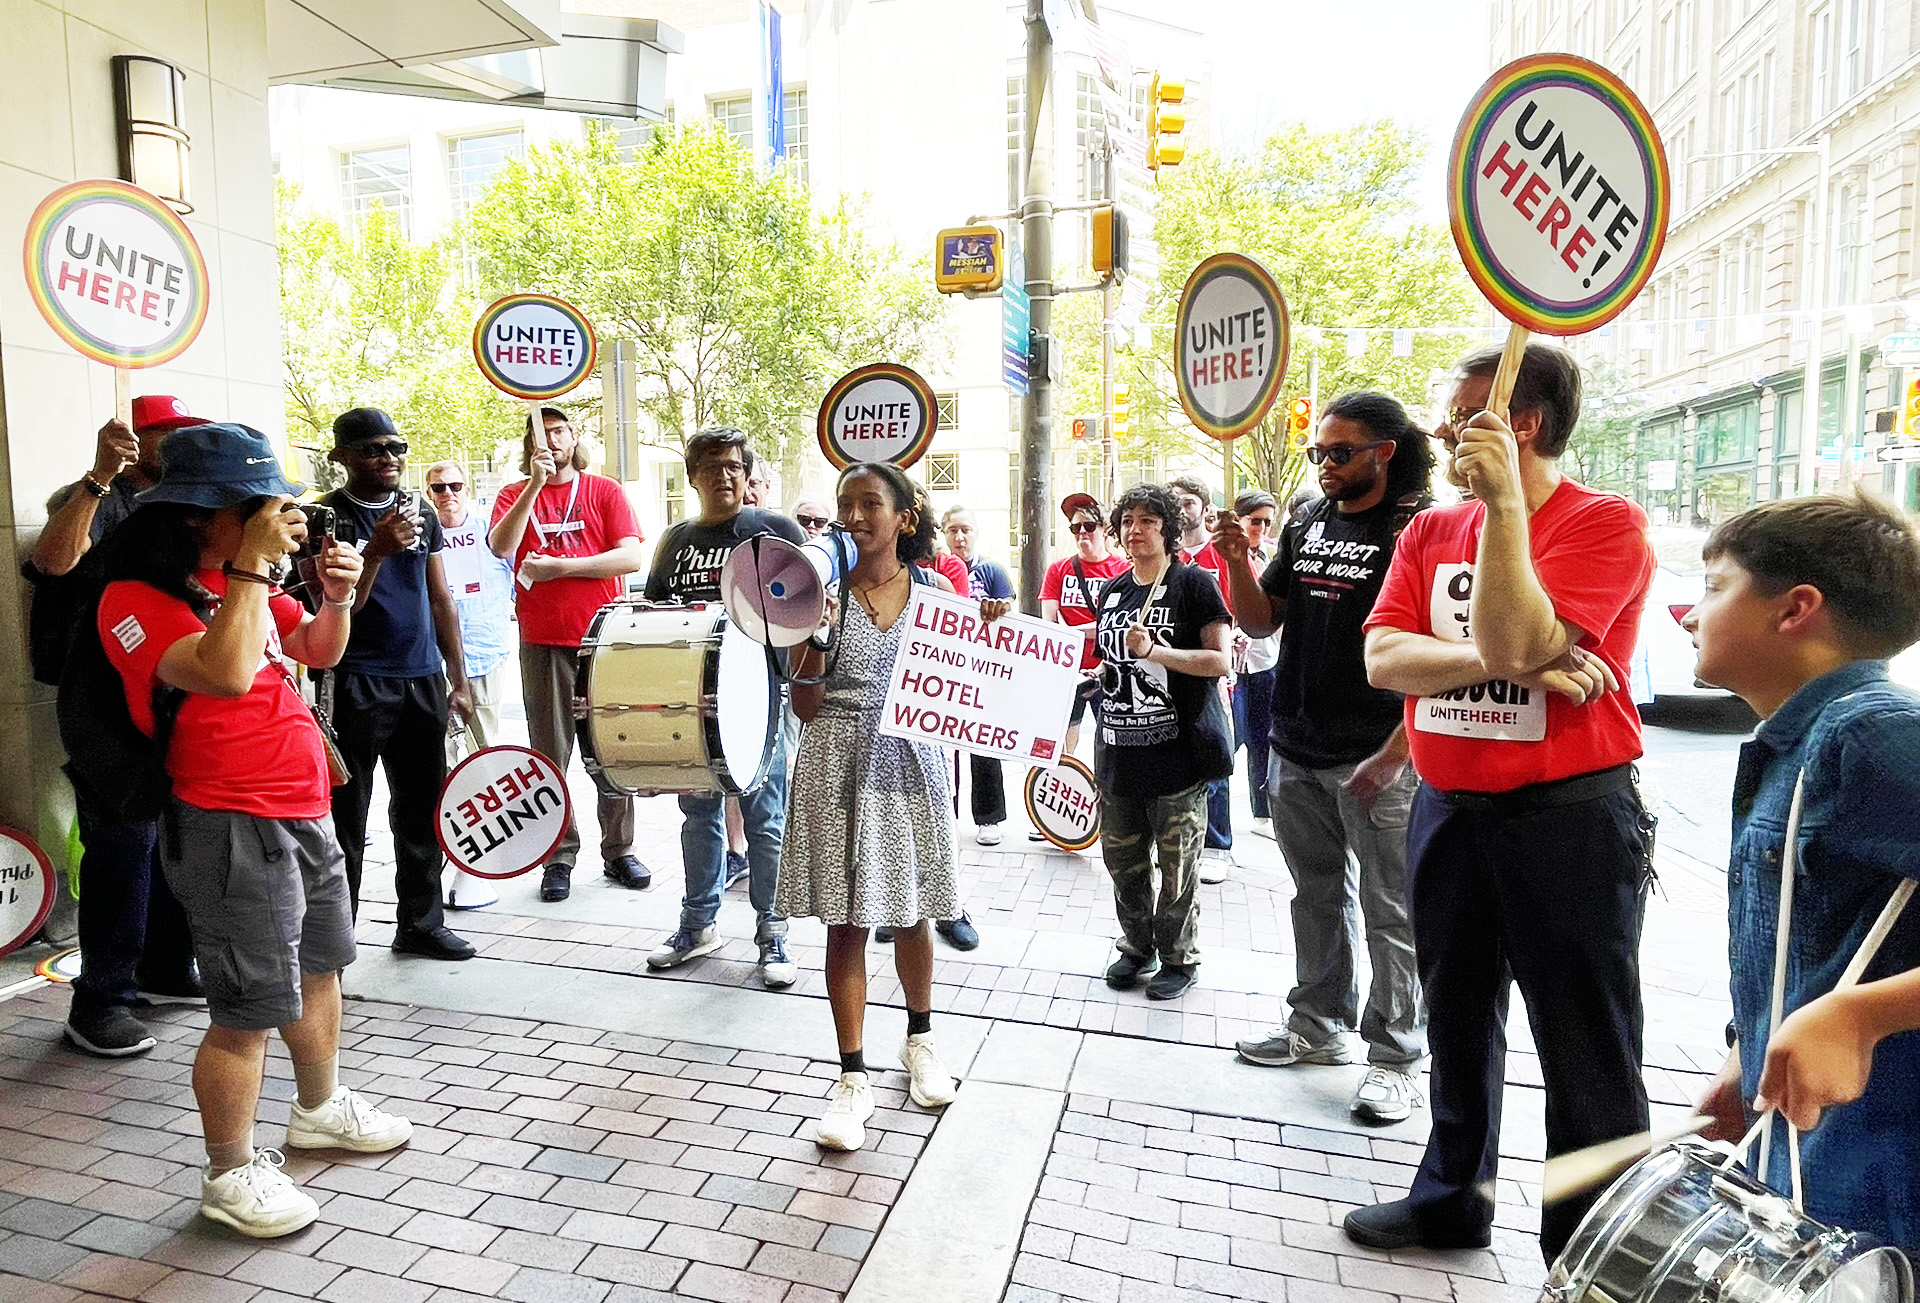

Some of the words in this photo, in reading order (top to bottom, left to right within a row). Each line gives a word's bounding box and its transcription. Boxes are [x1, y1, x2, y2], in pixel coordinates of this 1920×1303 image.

[1515, 100, 1639, 252] UNITE
[1482, 140, 1611, 289] HERE!
[65, 226, 183, 295] UNITE
[57, 261, 175, 326] HERE!
[496, 324, 576, 346] UNITE
[1191, 307, 1266, 354] UNITE
[495, 345, 573, 367] HERE!
[1193, 343, 1264, 388] HERE!
[842, 421, 908, 440] HERE!
[844, 403, 911, 421] UNITE
[441, 533, 475, 549] ANS
[675, 544, 732, 574] Phill
[1300, 538, 1380, 562] RESPECT
[1293, 560, 1323, 574] OUR
[1325, 563, 1374, 580] WORK
[913, 602, 1076, 669] LIBRARIANS
[909, 641, 967, 668] STAND
[971, 656, 1014, 681] WITH
[901, 669, 984, 710] HOTEL
[894, 703, 1019, 751] WORKERS
[1430, 706, 1518, 725] UNITEHERE!
[444, 758, 546, 838] HERE!
[1036, 788, 1089, 832] UNITE
[1042, 772, 1094, 816] HERE!
[457, 786, 562, 865] UNITE
[0, 863, 34, 883] Phi
